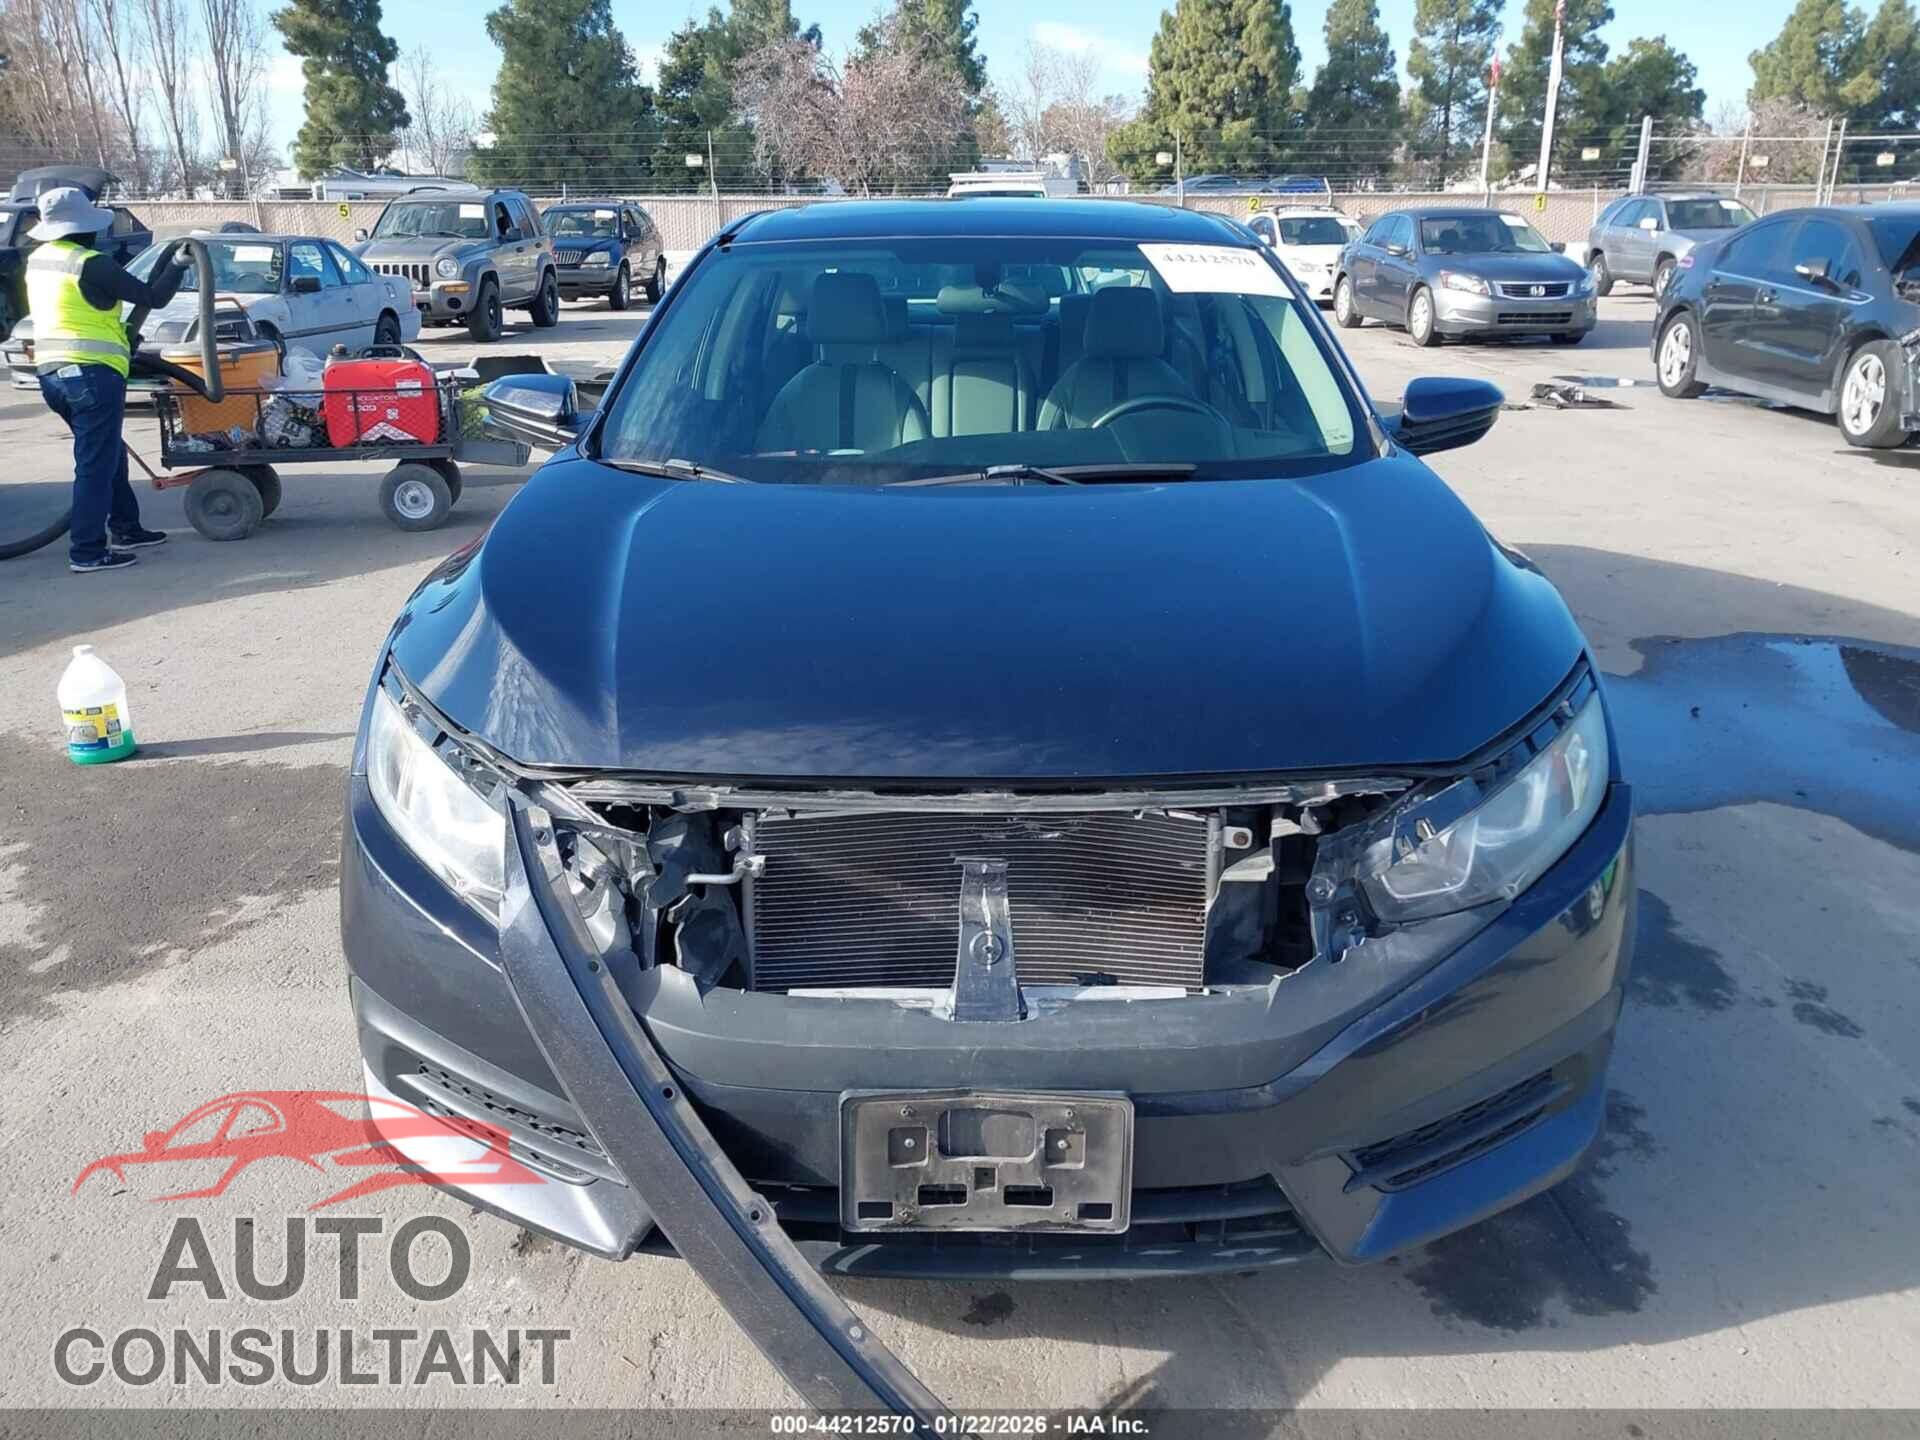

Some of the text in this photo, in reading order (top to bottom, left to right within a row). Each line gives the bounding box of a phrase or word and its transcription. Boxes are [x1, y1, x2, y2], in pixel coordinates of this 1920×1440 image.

[1250, 198, 1259, 210] 2
[1537, 195, 1544, 209] 1
[340, 204, 349, 217] 5
